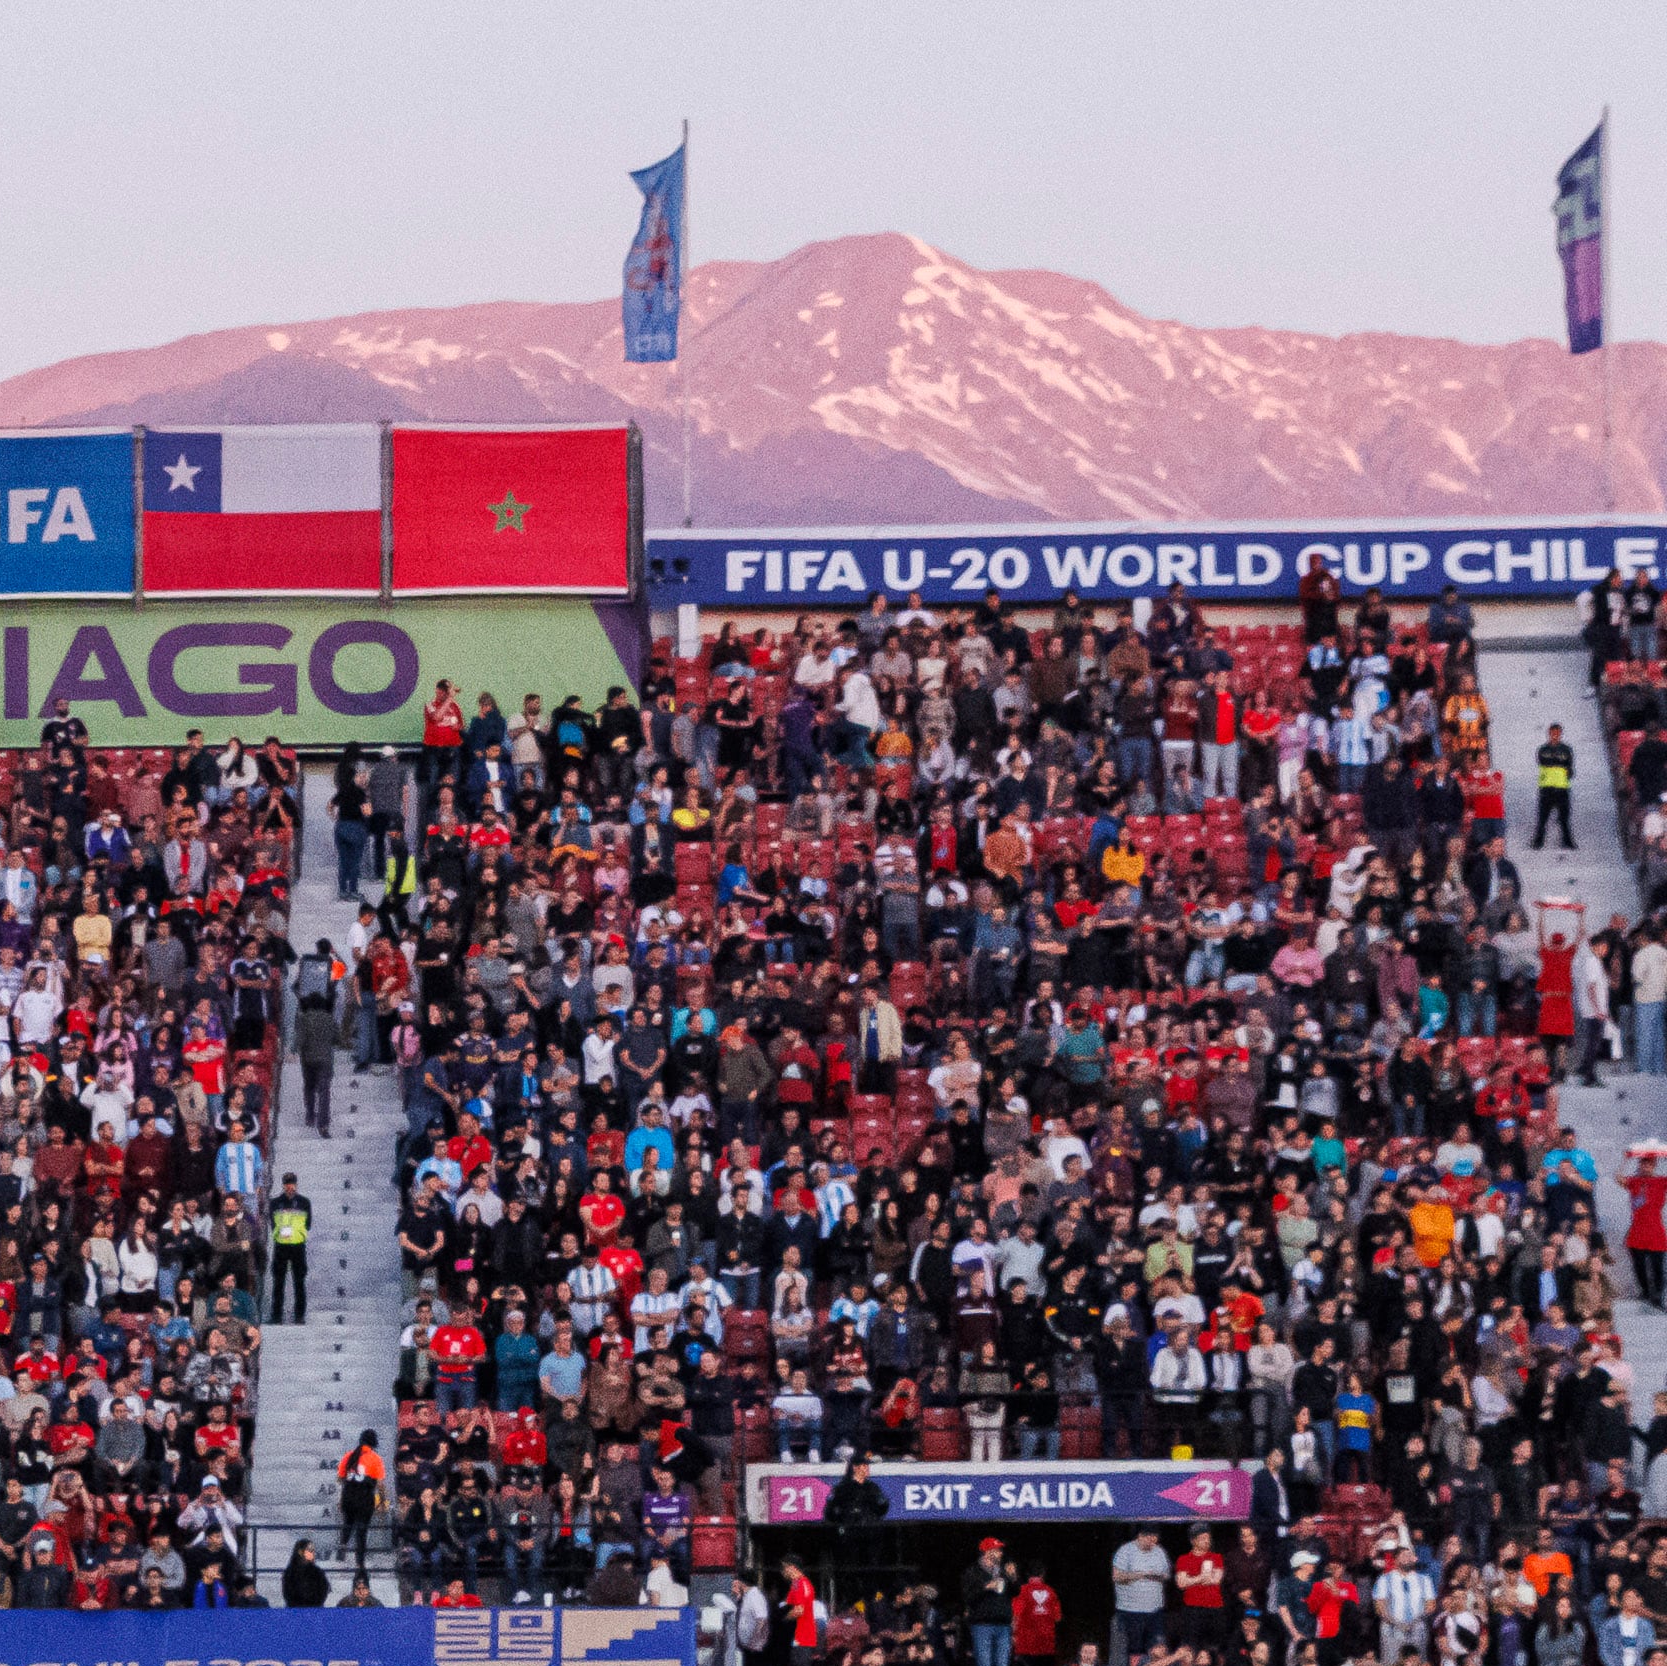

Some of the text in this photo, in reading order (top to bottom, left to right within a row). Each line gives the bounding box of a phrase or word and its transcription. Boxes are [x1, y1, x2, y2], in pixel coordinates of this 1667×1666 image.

[725, 538, 1659, 592] FIFA U-20 WORLD CUP CHILE
[779, 1486, 814, 1513] 21
[904, 1483, 972, 1511] EXIT
[999, 1481, 1114, 1509] SALIDA
[1195, 1479, 1231, 1507] 21
